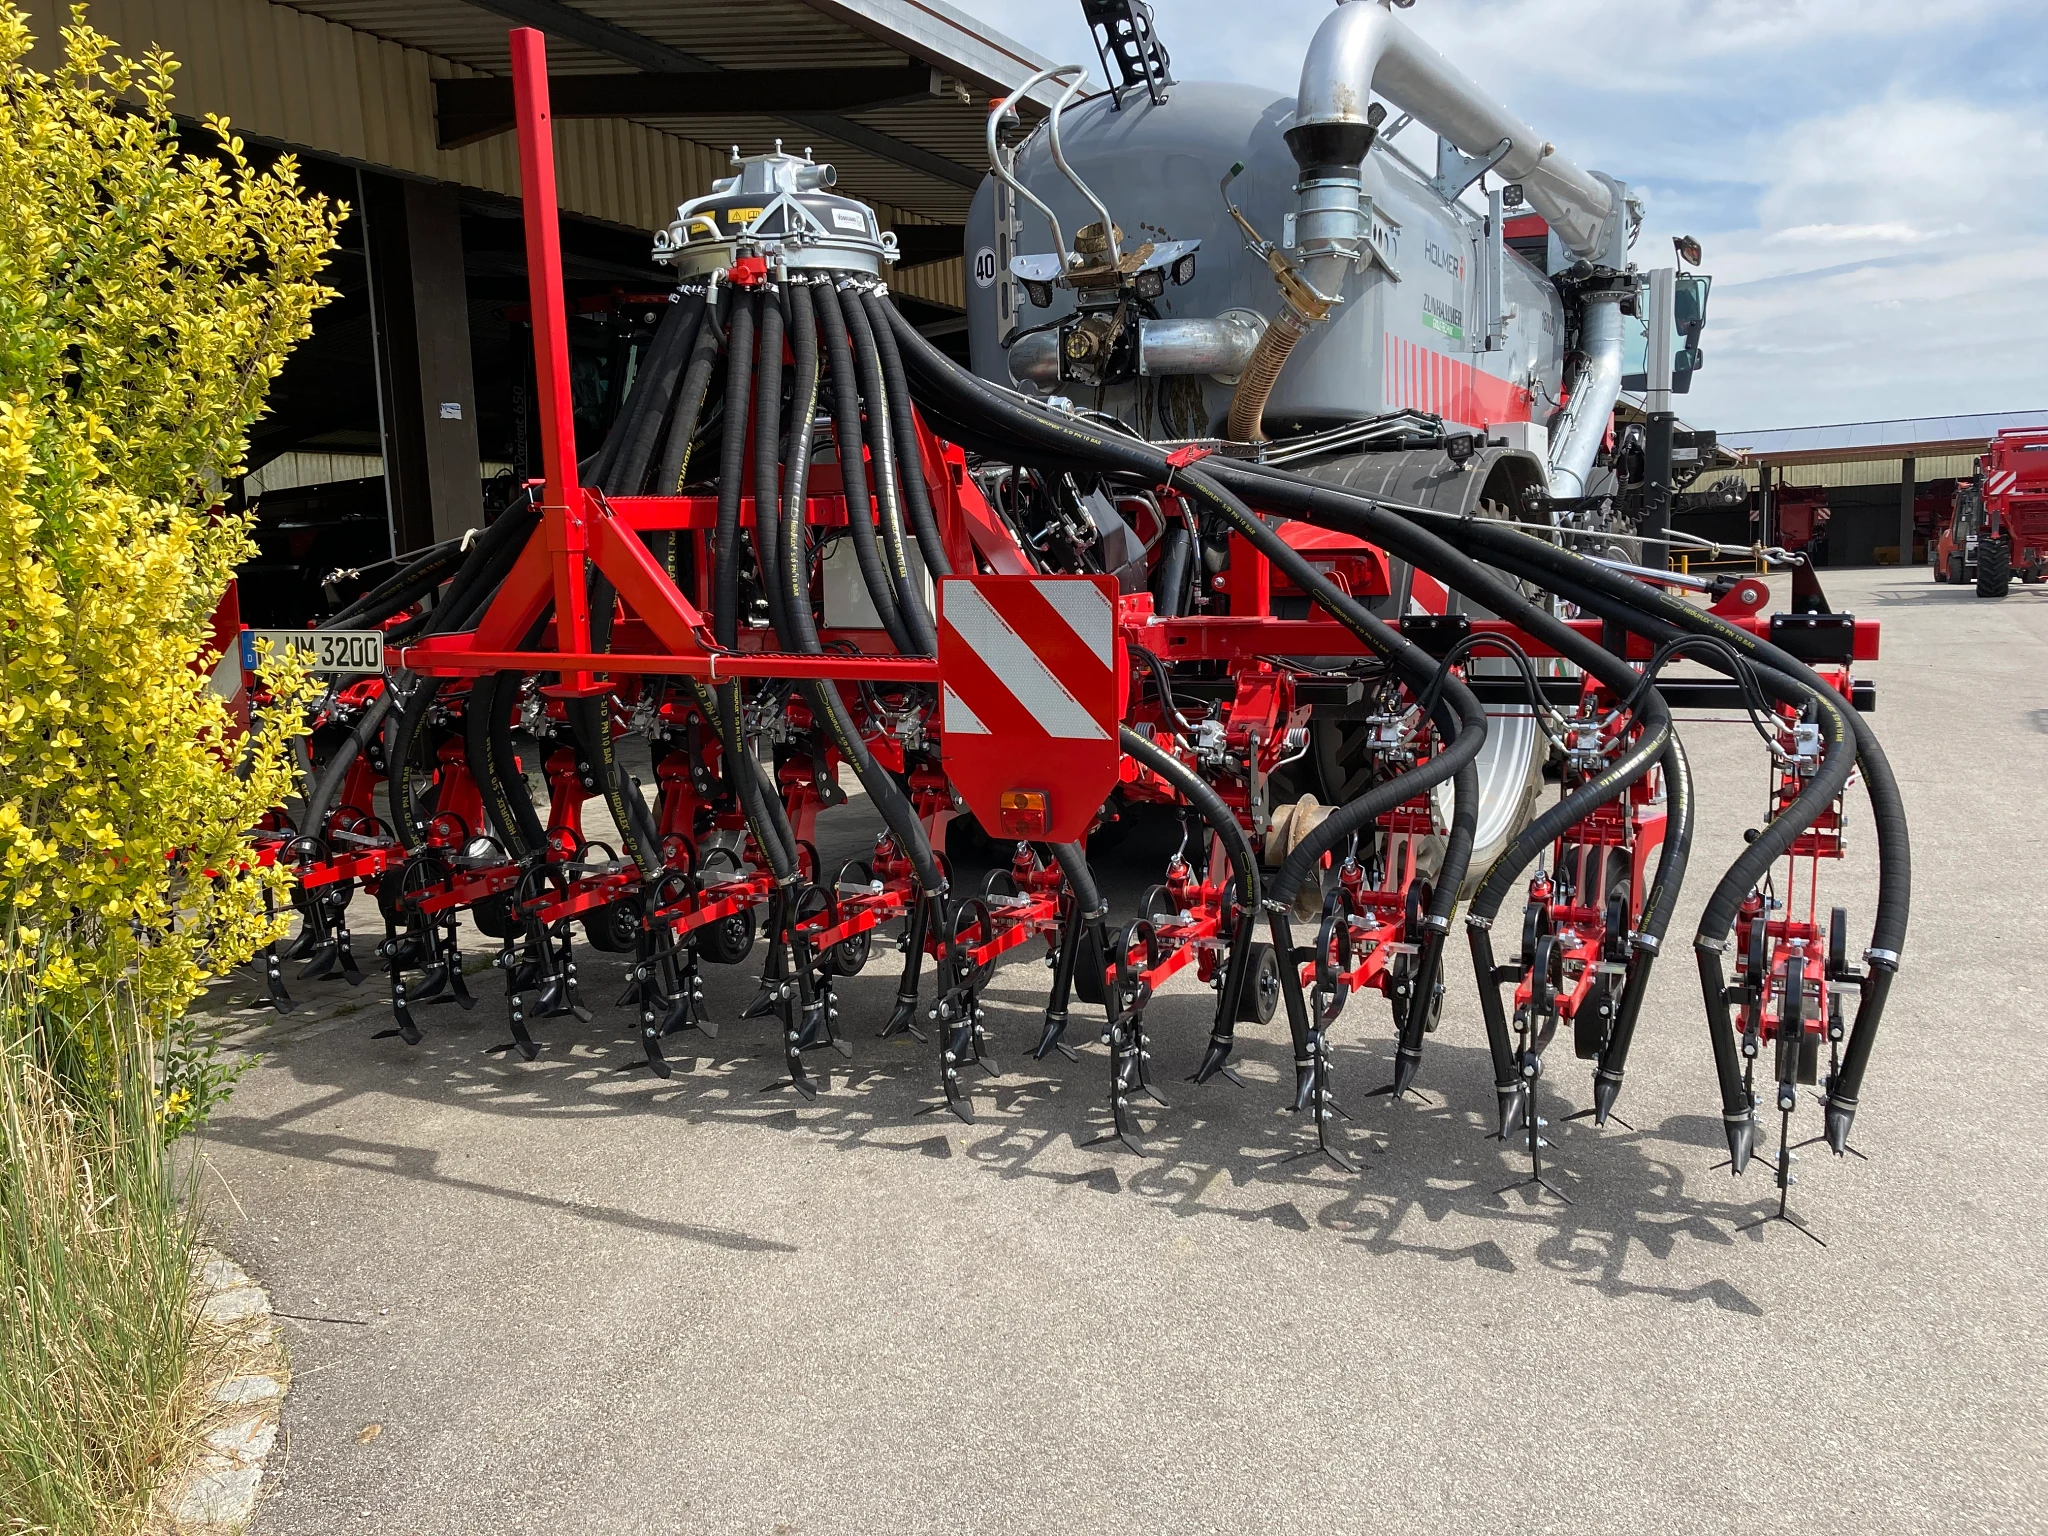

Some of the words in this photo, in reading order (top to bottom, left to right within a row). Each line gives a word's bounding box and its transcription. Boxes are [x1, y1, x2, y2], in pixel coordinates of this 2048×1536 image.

[976, 253, 995, 281] 40
[1424, 239, 1459, 278] HOLMER
[1196, 483, 1220, 503] HEDUFLEX
[1231, 510, 1240, 520] PN
[1239, 517, 1246, 526] 10
[1245, 524, 1256, 535] BAR
[668, 531, 676, 546] PN
[668, 551, 676, 562] 10
[1683, 607, 1711, 625] HEDUFLEX
[1713, 623, 1725, 632] S/D
[1725, 629, 1735, 638] PN
[1735, 634, 1743, 642] 10
[1741, 639, 1756, 650] BAR
[321, 636, 379, 667] 3200
[703, 701, 716, 715] PN
[711, 715, 722, 726] 10
[601, 720, 609, 734] PN
[602, 736, 610, 746] 10
[603, 747, 613, 765] BAR
[402, 766, 410, 783] BAR
[491, 776, 500, 791] S/D
[402, 784, 409, 795] 10
[402, 796, 410, 808] PN
[496, 796, 517, 836] HEDUFLEX
[611, 791, 630, 831] HEDUFLEX
[626, 837, 638, 851] S/D
[634, 854, 645, 865] PN
